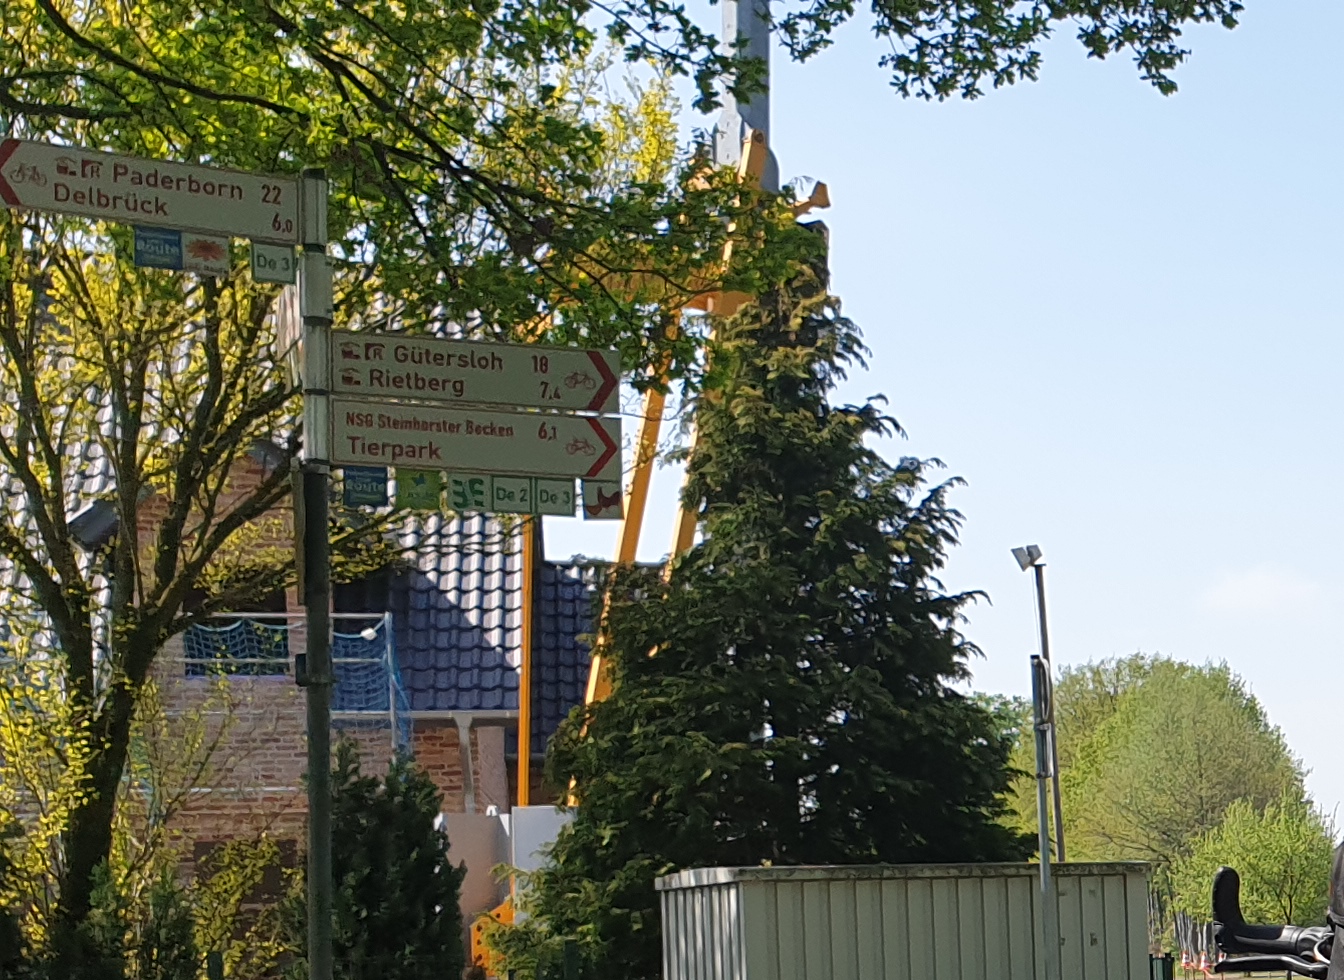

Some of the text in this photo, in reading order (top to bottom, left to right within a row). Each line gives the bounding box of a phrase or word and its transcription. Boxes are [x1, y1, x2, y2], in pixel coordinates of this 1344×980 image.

[113, 163, 281, 205] Paderborn 22
[54, 183, 168, 216] Delbrück
[281, 258, 290, 271] 3
[394, 345, 548, 373] Gütersloh 18
[369, 369, 561, 399] Rietberg 7,4
[346, 412, 374, 428] NSG
[466, 420, 514, 437] Becken
[538, 421, 558, 441] 6,1
[347, 436, 442, 461] Tierpark
[496, 486, 528, 501] De 2
[539, 488, 571, 505] De 3
